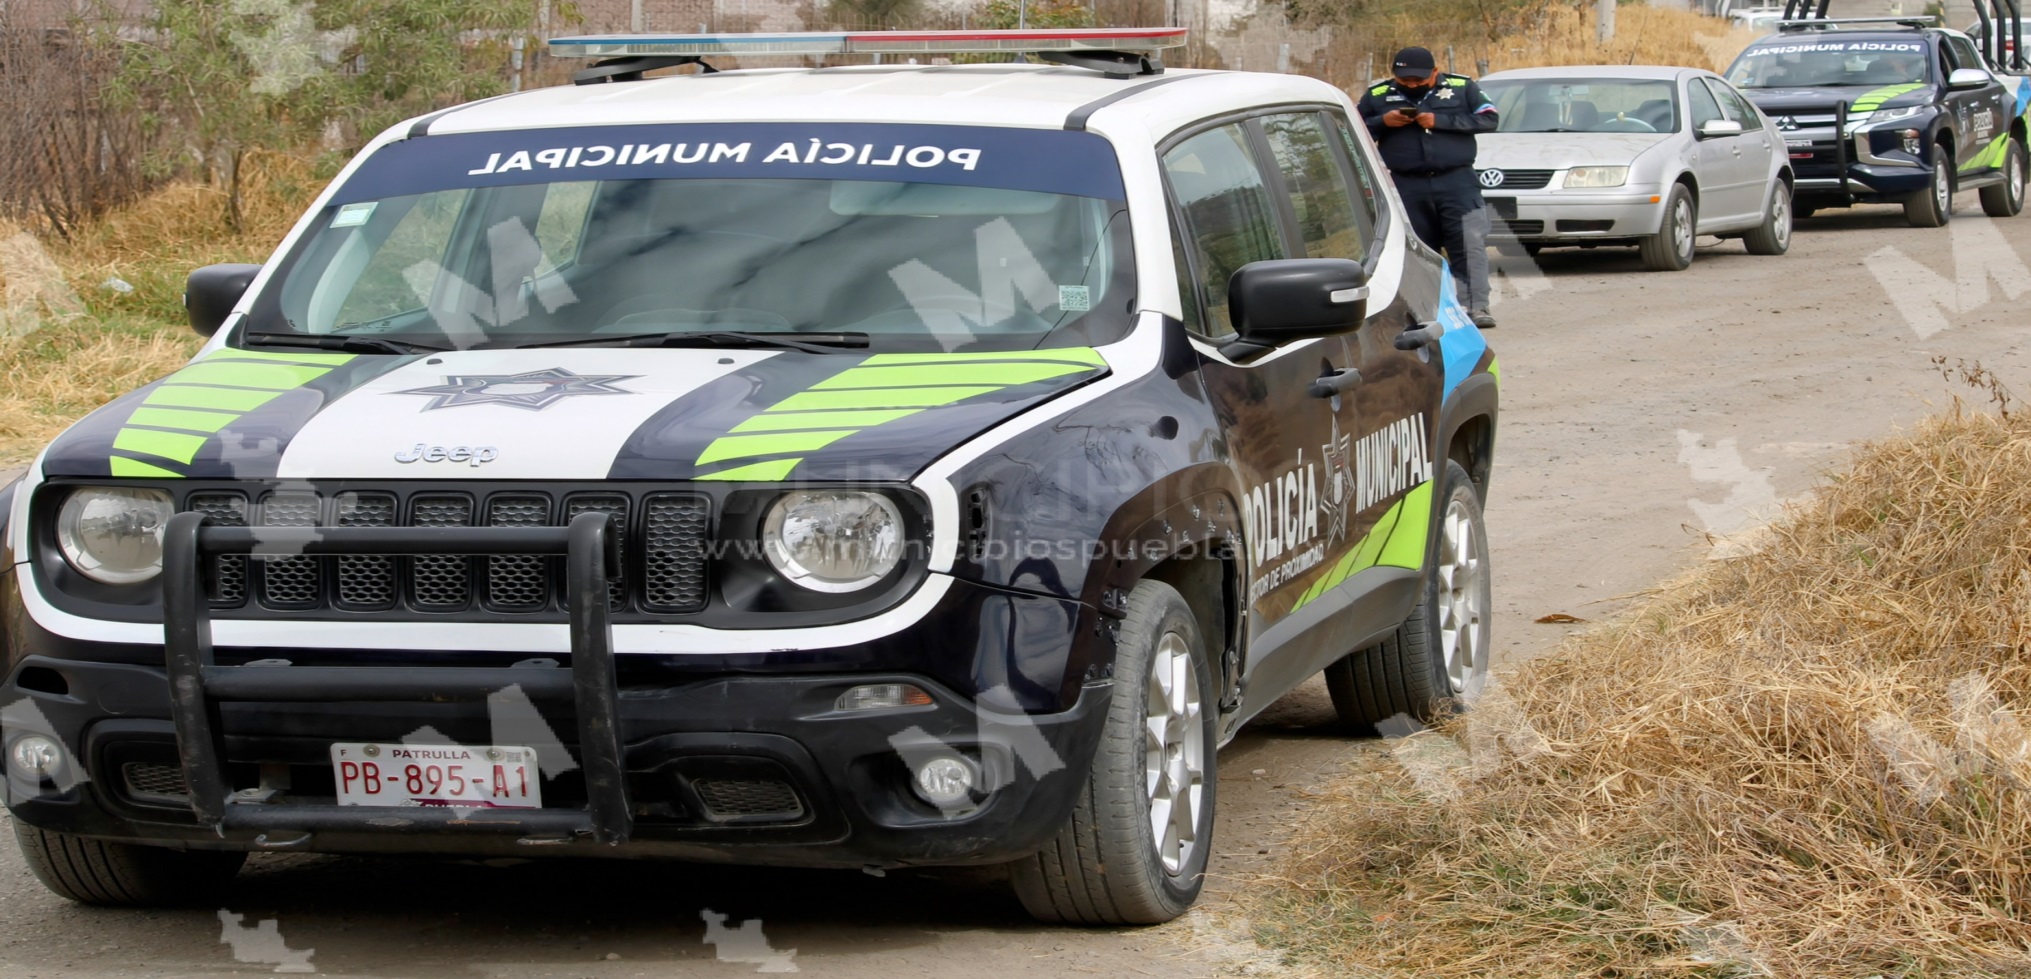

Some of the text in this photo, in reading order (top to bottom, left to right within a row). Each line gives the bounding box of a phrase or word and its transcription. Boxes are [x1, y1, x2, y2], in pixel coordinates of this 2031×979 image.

[394, 443, 499, 467] Jeep
[1243, 412, 1433, 575] POLICÍA MUNICIPAL
[1269, 567, 1281, 590] DE
[392, 749, 471, 760] PATRULLA
[340, 761, 528, 798] PB-895-A1
